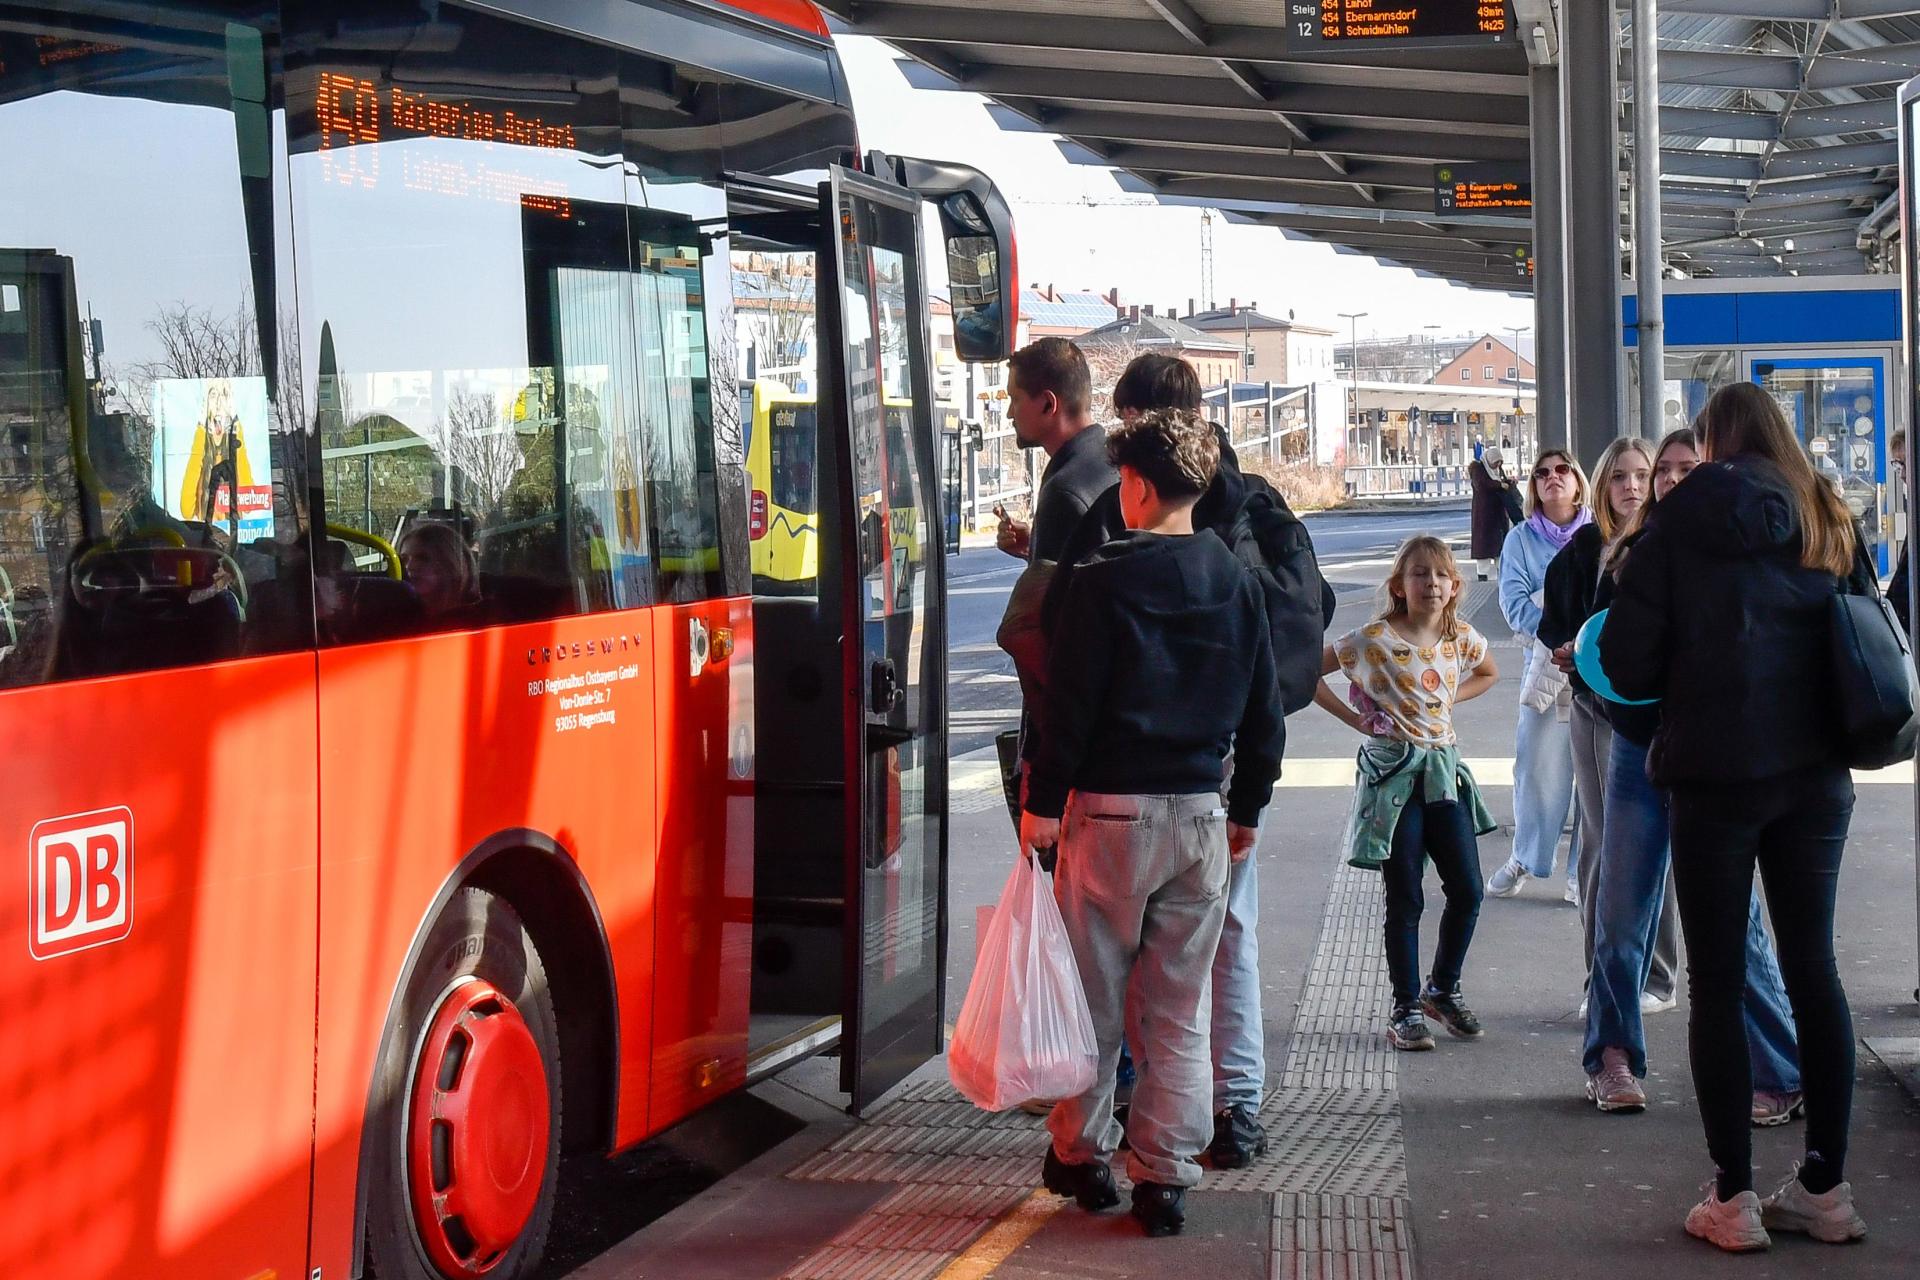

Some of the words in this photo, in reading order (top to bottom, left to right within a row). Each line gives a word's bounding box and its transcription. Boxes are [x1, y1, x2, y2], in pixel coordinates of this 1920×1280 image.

[1292, 5, 1316, 16] Steig
[1321, 0, 1339, 9] 454
[1321, 13, 1339, 23] 454
[1345, 8, 1417, 22] Ebermannsdorf
[1477, 6, 1504, 17] 49min
[1297, 22, 1313, 37] 12
[1321, 27, 1340, 37] 454
[1346, 23, 1409, 36] Schmidmühlen
[1478, 20, 1505, 32] 14:25
[1441, 198, 1450, 207] 13
[527, 633, 641, 666] CROSSWAY
[528, 680, 544, 696] RBO
[545, 674, 585, 695] Regionalbus
[586, 670, 618, 685] Ostbayern
[618, 664, 639, 680] GmbH
[606, 688, 611, 702] 7
[555, 714, 577, 732] 93055
[579, 709, 616, 729] Regensburg
[45, 834, 121, 933] DB
